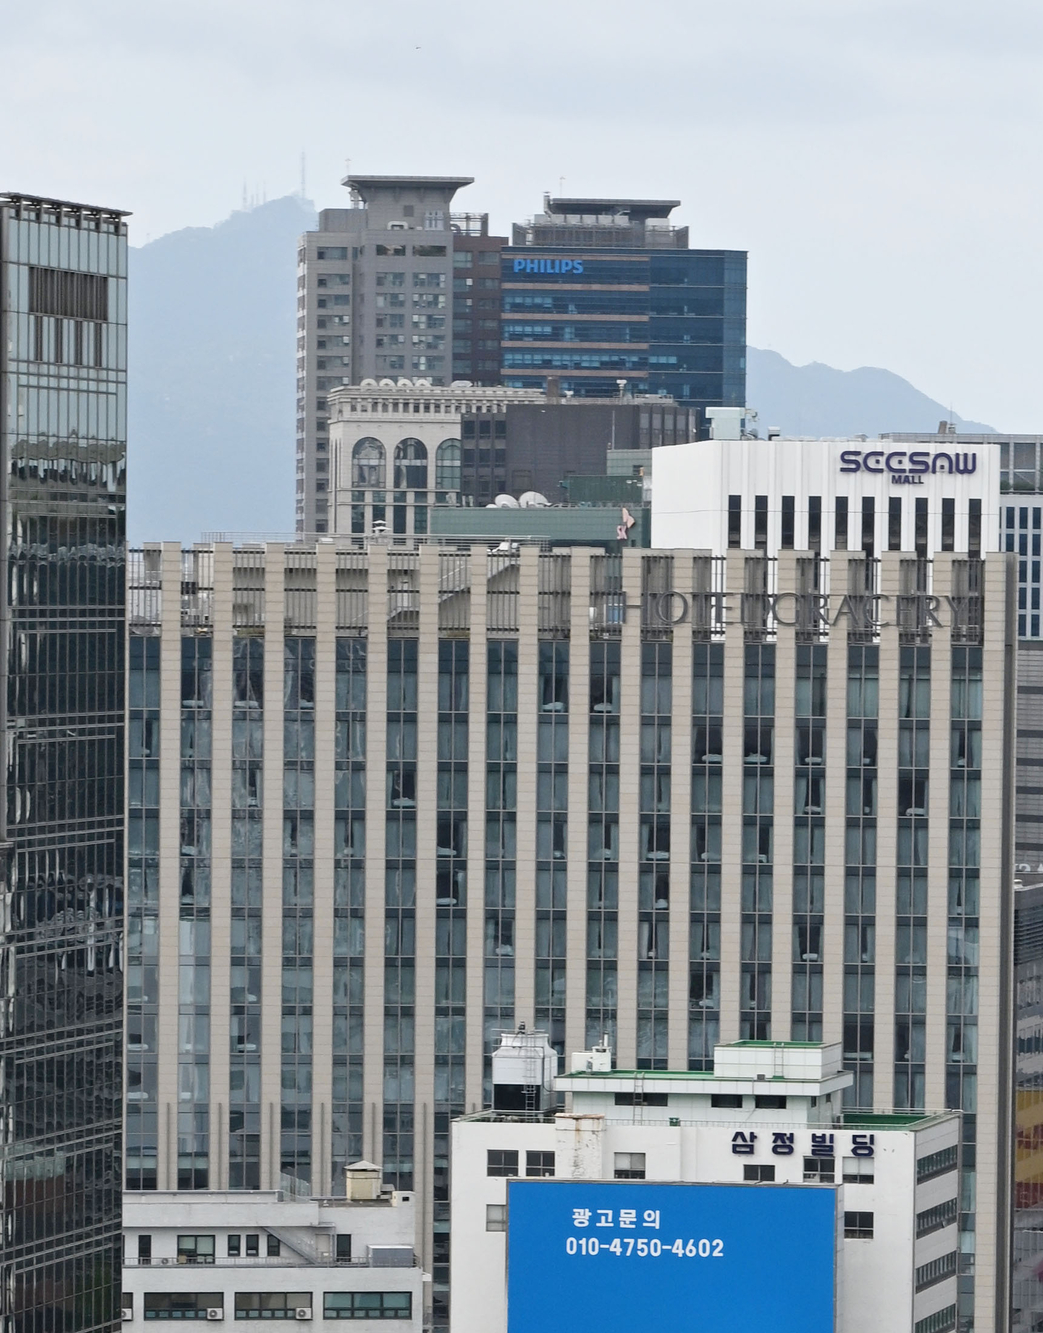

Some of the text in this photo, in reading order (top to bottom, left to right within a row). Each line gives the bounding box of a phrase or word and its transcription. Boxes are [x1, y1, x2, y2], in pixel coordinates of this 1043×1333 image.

[513, 258, 584, 274] PHILIPS
[840, 450, 977, 475] SEESAW
[891, 474, 925, 485] MALL
[624, 590, 965, 629] HOTEL GRACERY
[731, 1130, 876, 1158] 삼정빌딩
[572, 1207, 661, 1230] 광고문의
[566, 1237, 725, 1258] 010-4750-4602
